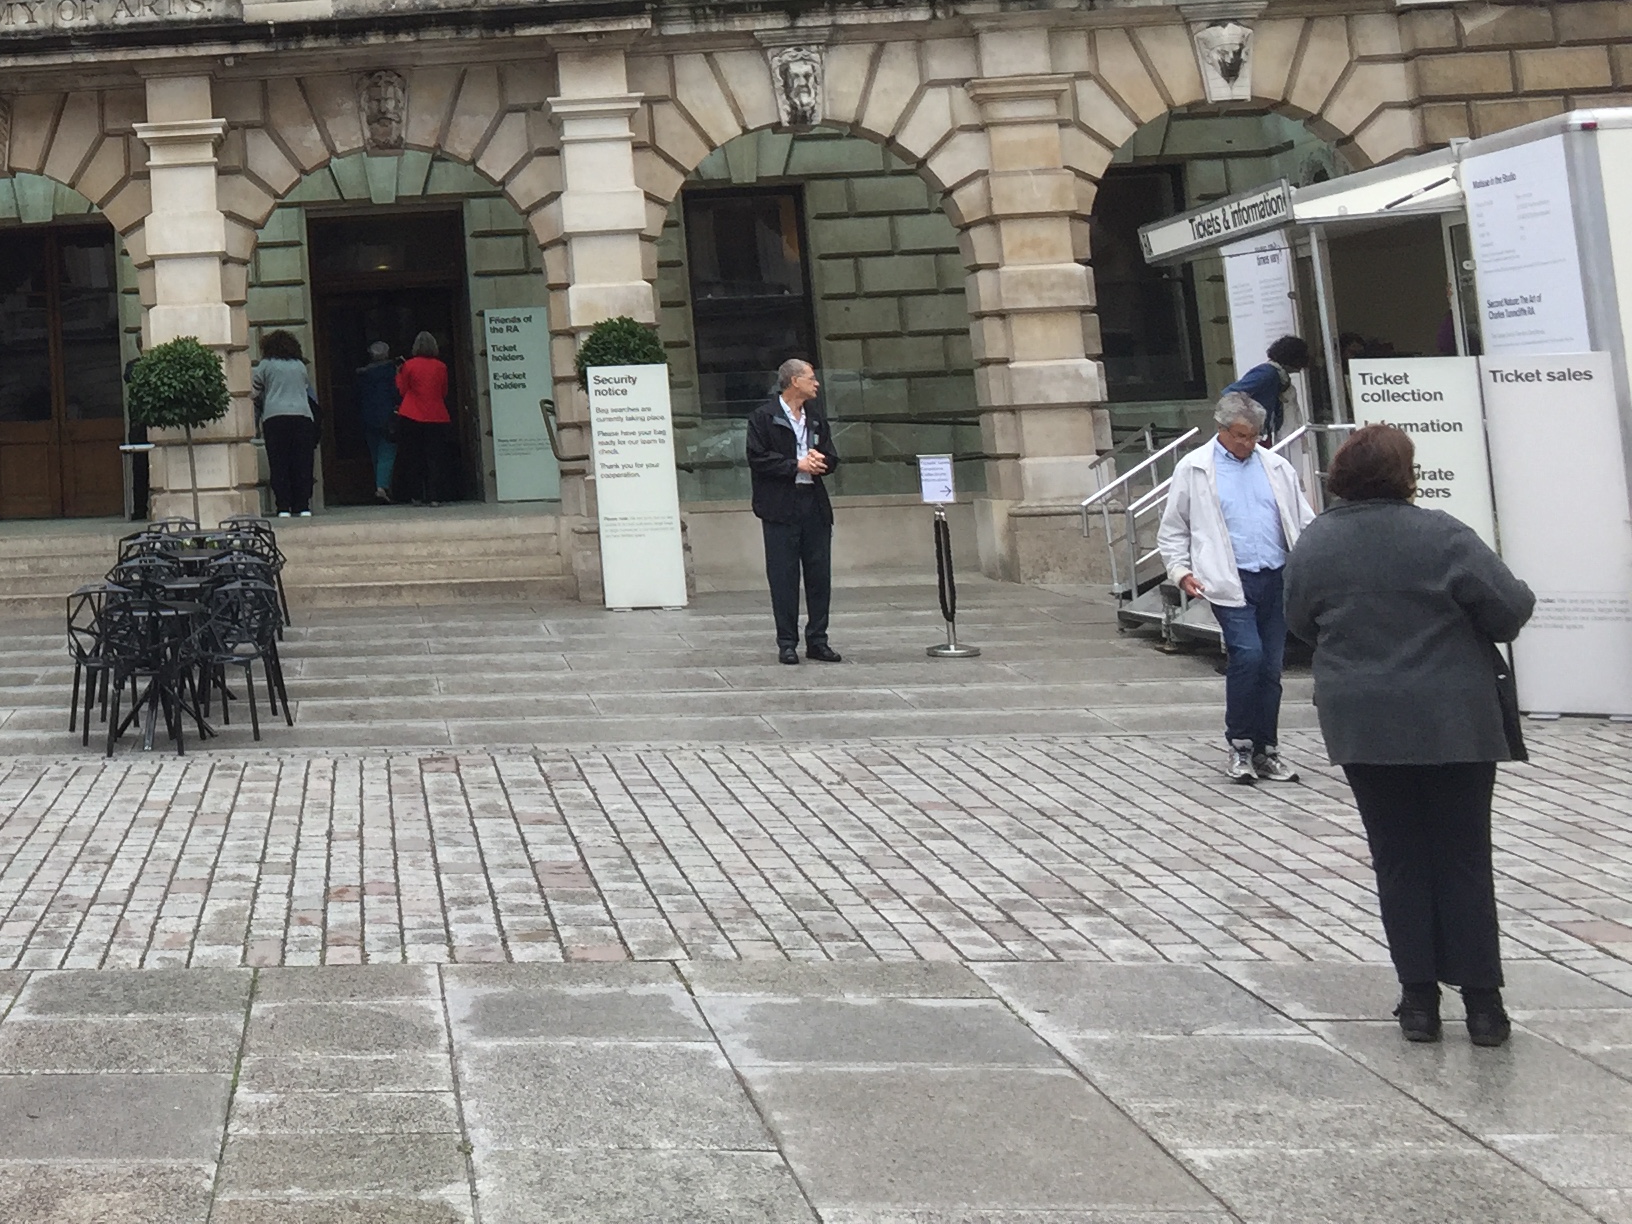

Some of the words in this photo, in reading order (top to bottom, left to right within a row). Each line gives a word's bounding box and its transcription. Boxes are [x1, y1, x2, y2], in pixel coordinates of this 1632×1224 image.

[1188, 214, 1222, 240] Tickets
[1221, 208, 1232, 230] &
[1229, 192, 1284, 228] information
[489, 316, 521, 324] Friends
[523, 315, 533, 323] of
[489, 326, 504, 334] the
[506, 325, 520, 333] RA
[491, 344, 517, 352] Ticket
[492, 353, 525, 362] holders
[493, 372, 527, 381] E-ticket
[593, 374, 637, 385] Security
[1358, 372, 1410, 385] Ticket
[1489, 369, 1542, 383] Ticket
[1546, 367, 1593, 382] sales
[493, 382, 527, 390] holders
[594, 387, 628, 396] notice
[1361, 389, 1444, 403] collection
